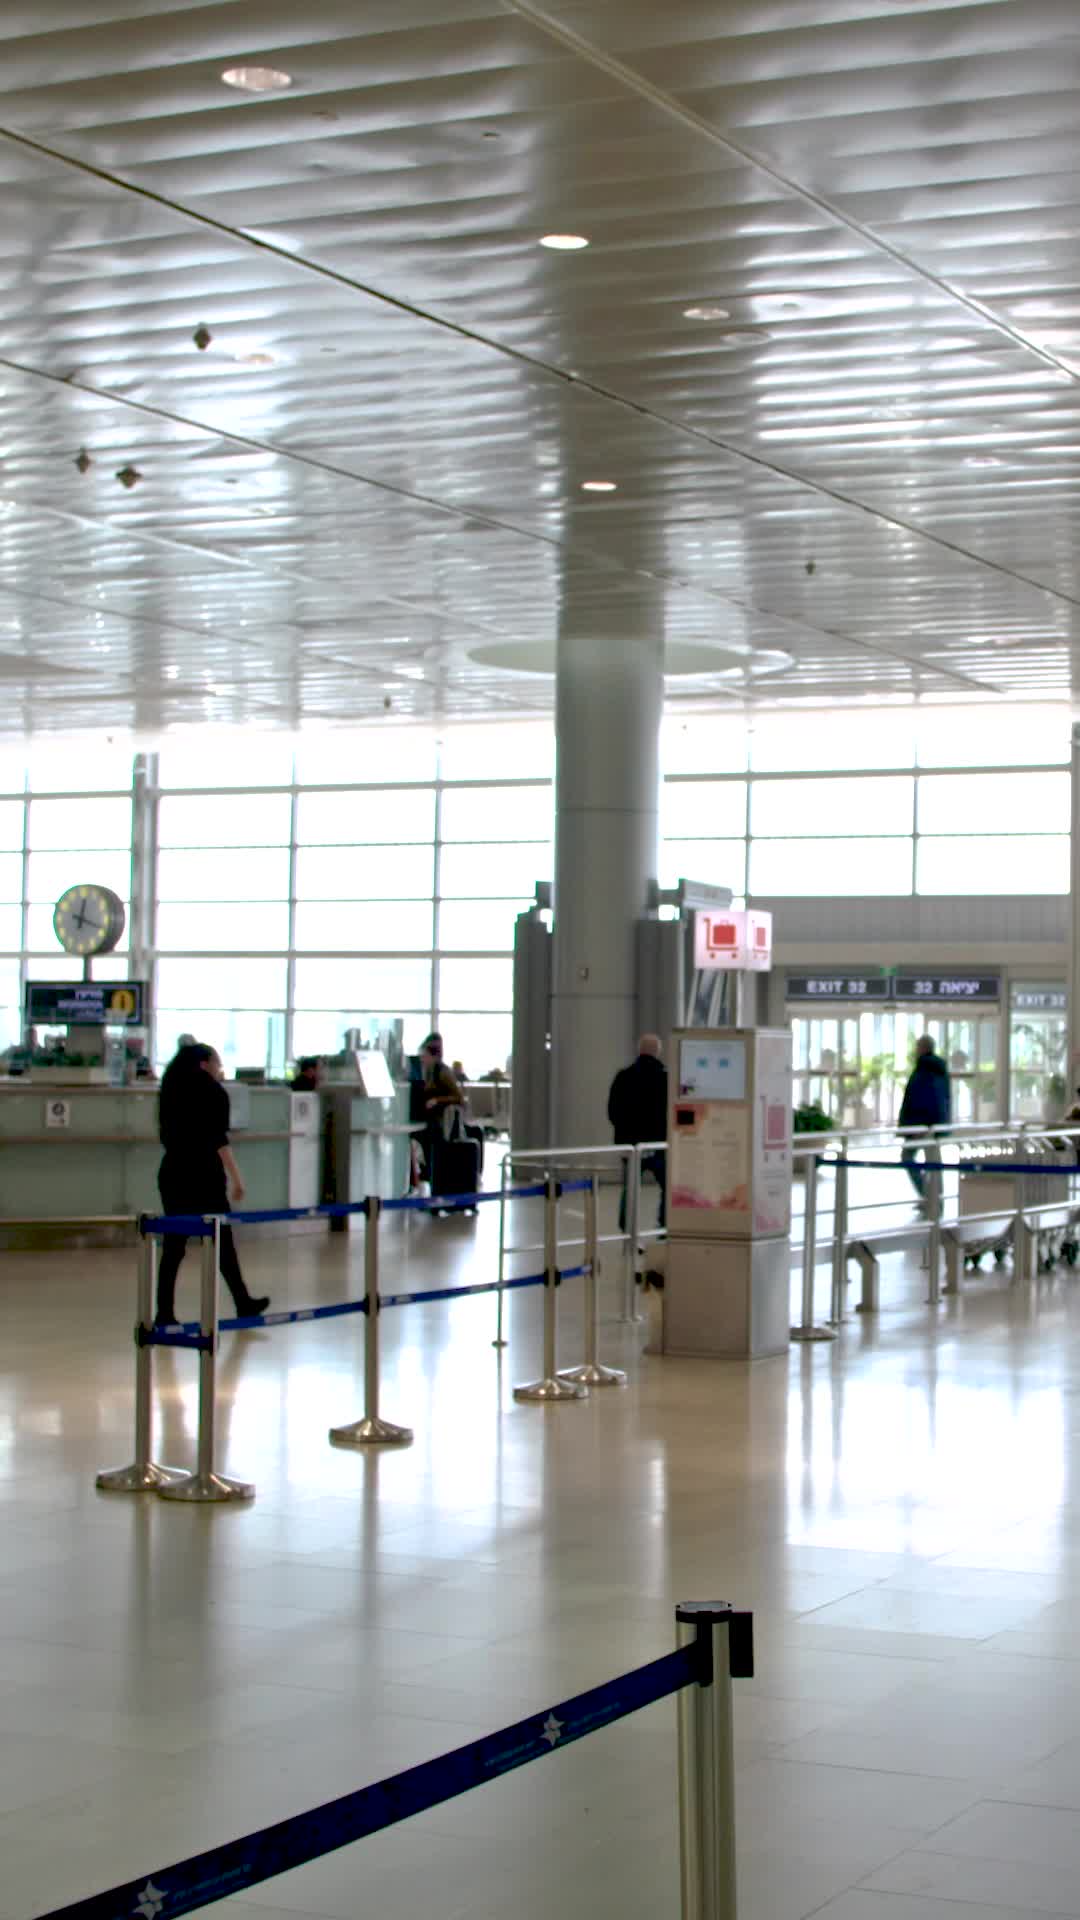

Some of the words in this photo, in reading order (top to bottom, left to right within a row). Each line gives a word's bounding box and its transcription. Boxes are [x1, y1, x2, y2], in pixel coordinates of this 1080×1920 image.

[806, 980, 843, 994] EXIT
[847, 980, 867, 994] 32
[914, 981, 933, 994] 32
[939, 981, 980, 995] יציאה
[1016, 994, 1045, 1007] EXIT
